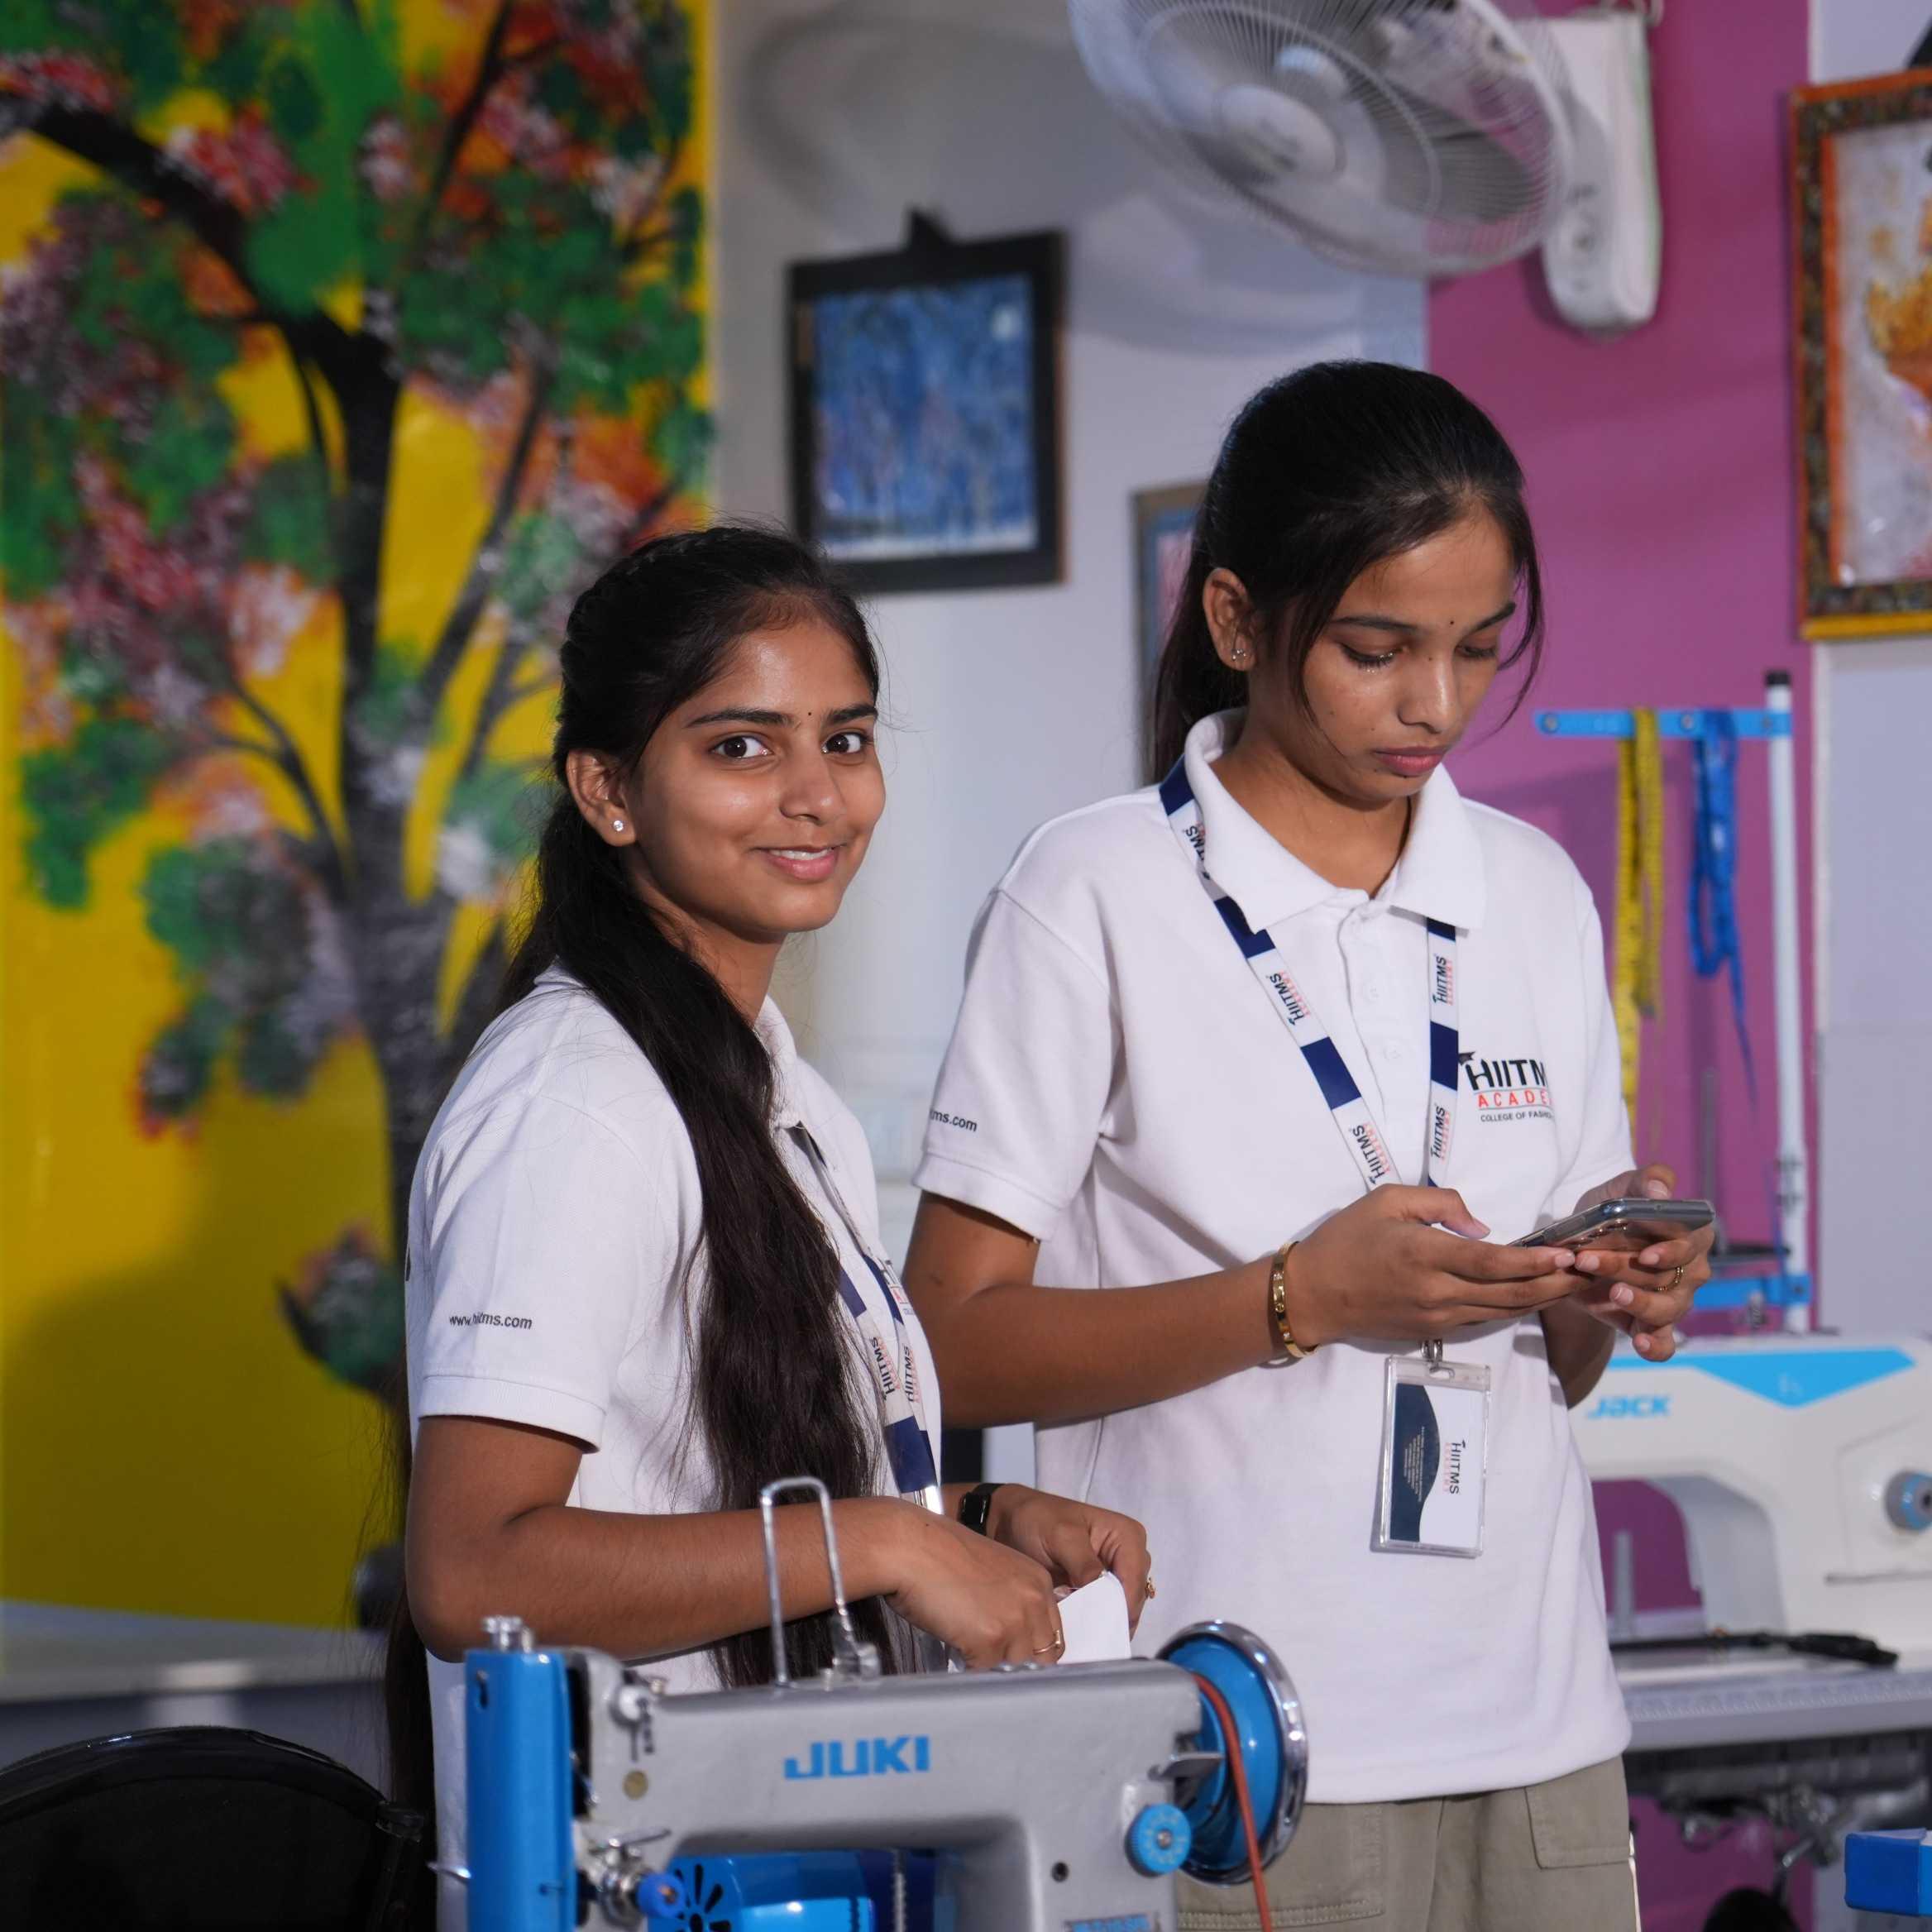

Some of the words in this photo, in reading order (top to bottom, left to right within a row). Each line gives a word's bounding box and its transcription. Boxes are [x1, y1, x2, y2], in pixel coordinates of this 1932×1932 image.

[1270, 973, 1304, 1021] HIITMS
[1437, 956, 1447, 1003] HIITMS
[1478, 1089, 1552, 1108] ACADE
[1480, 1112, 1514, 1122] COLLEGE
[1515, 1112, 1526, 1120] OF
[1352, 1125, 1385, 1179] HIITMS
[1432, 1106, 1446, 1159] HIITMS
[871, 1337, 896, 1395] HIITMS
[1449, 1442, 1461, 1494] HIITMS
[784, 1734, 930, 1779] JUKI
